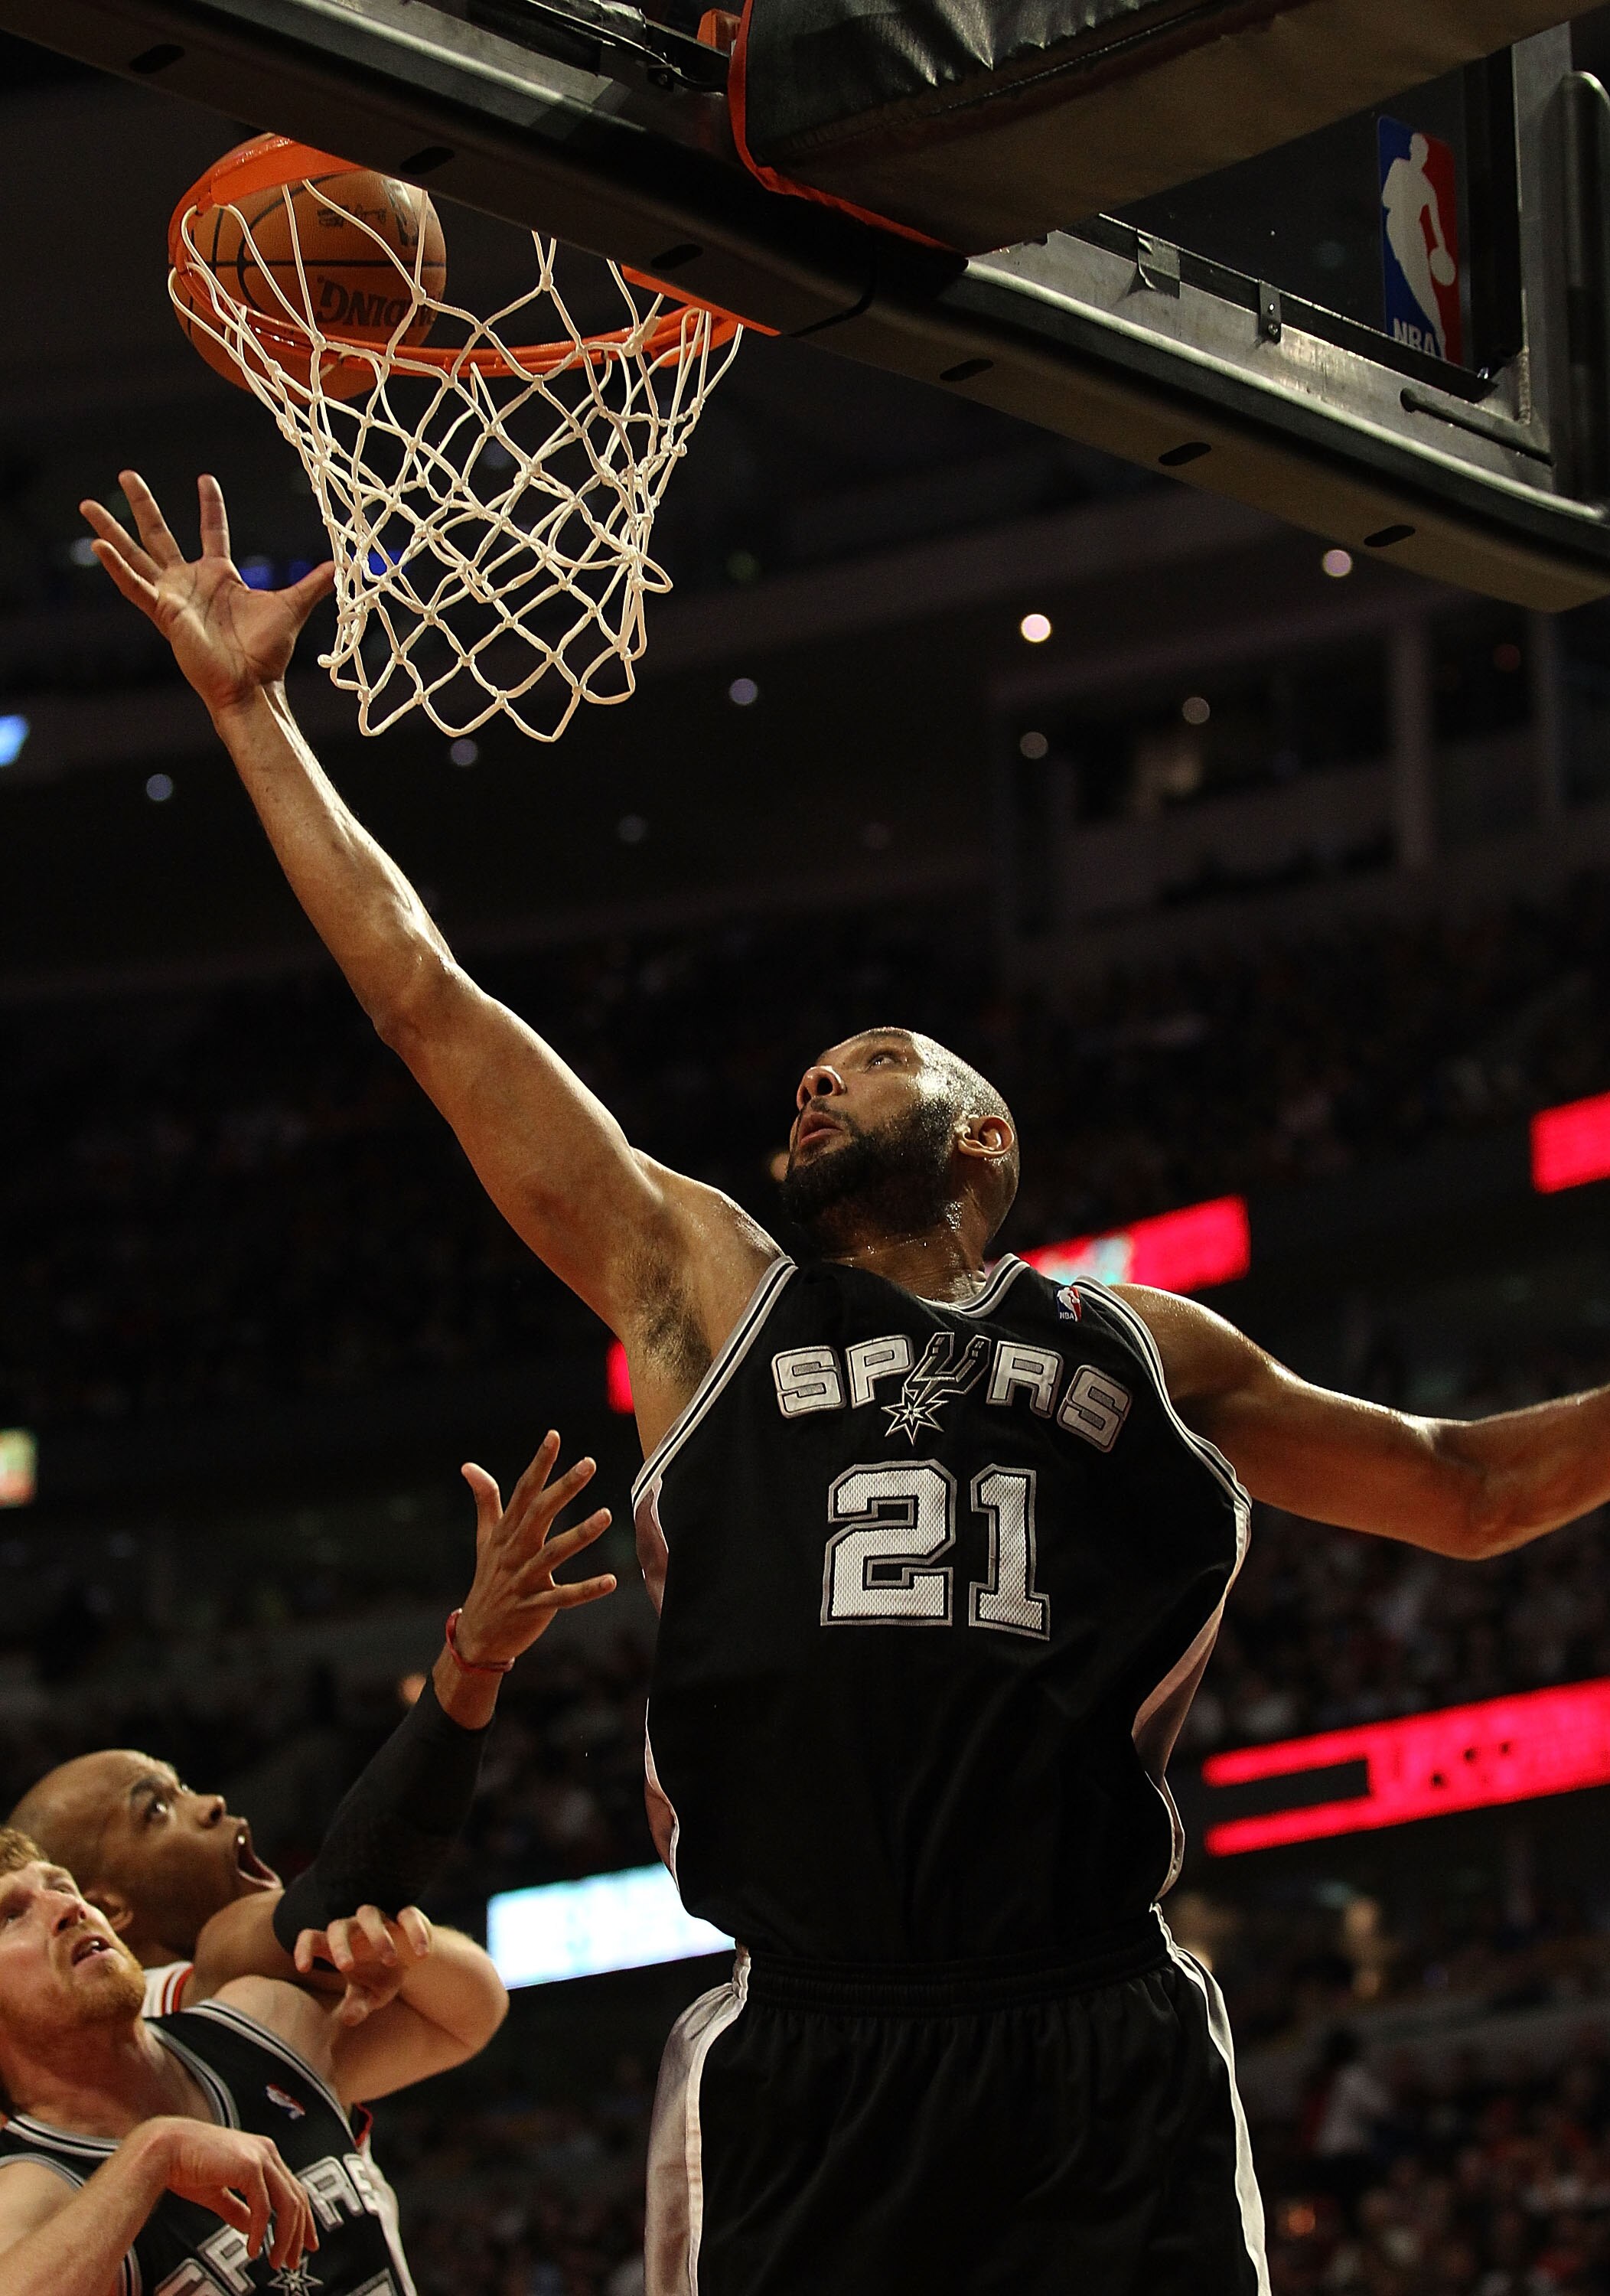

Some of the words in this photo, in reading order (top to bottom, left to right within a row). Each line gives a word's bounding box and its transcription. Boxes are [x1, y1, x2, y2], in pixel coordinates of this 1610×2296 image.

[1393, 317, 1436, 357] NBA
[1059, 1312, 1075, 1320] NBA
[771, 1332, 1133, 1453] SPURS
[820, 1459, 1051, 1641] 21
[154, 2152, 383, 2296] SPRS
